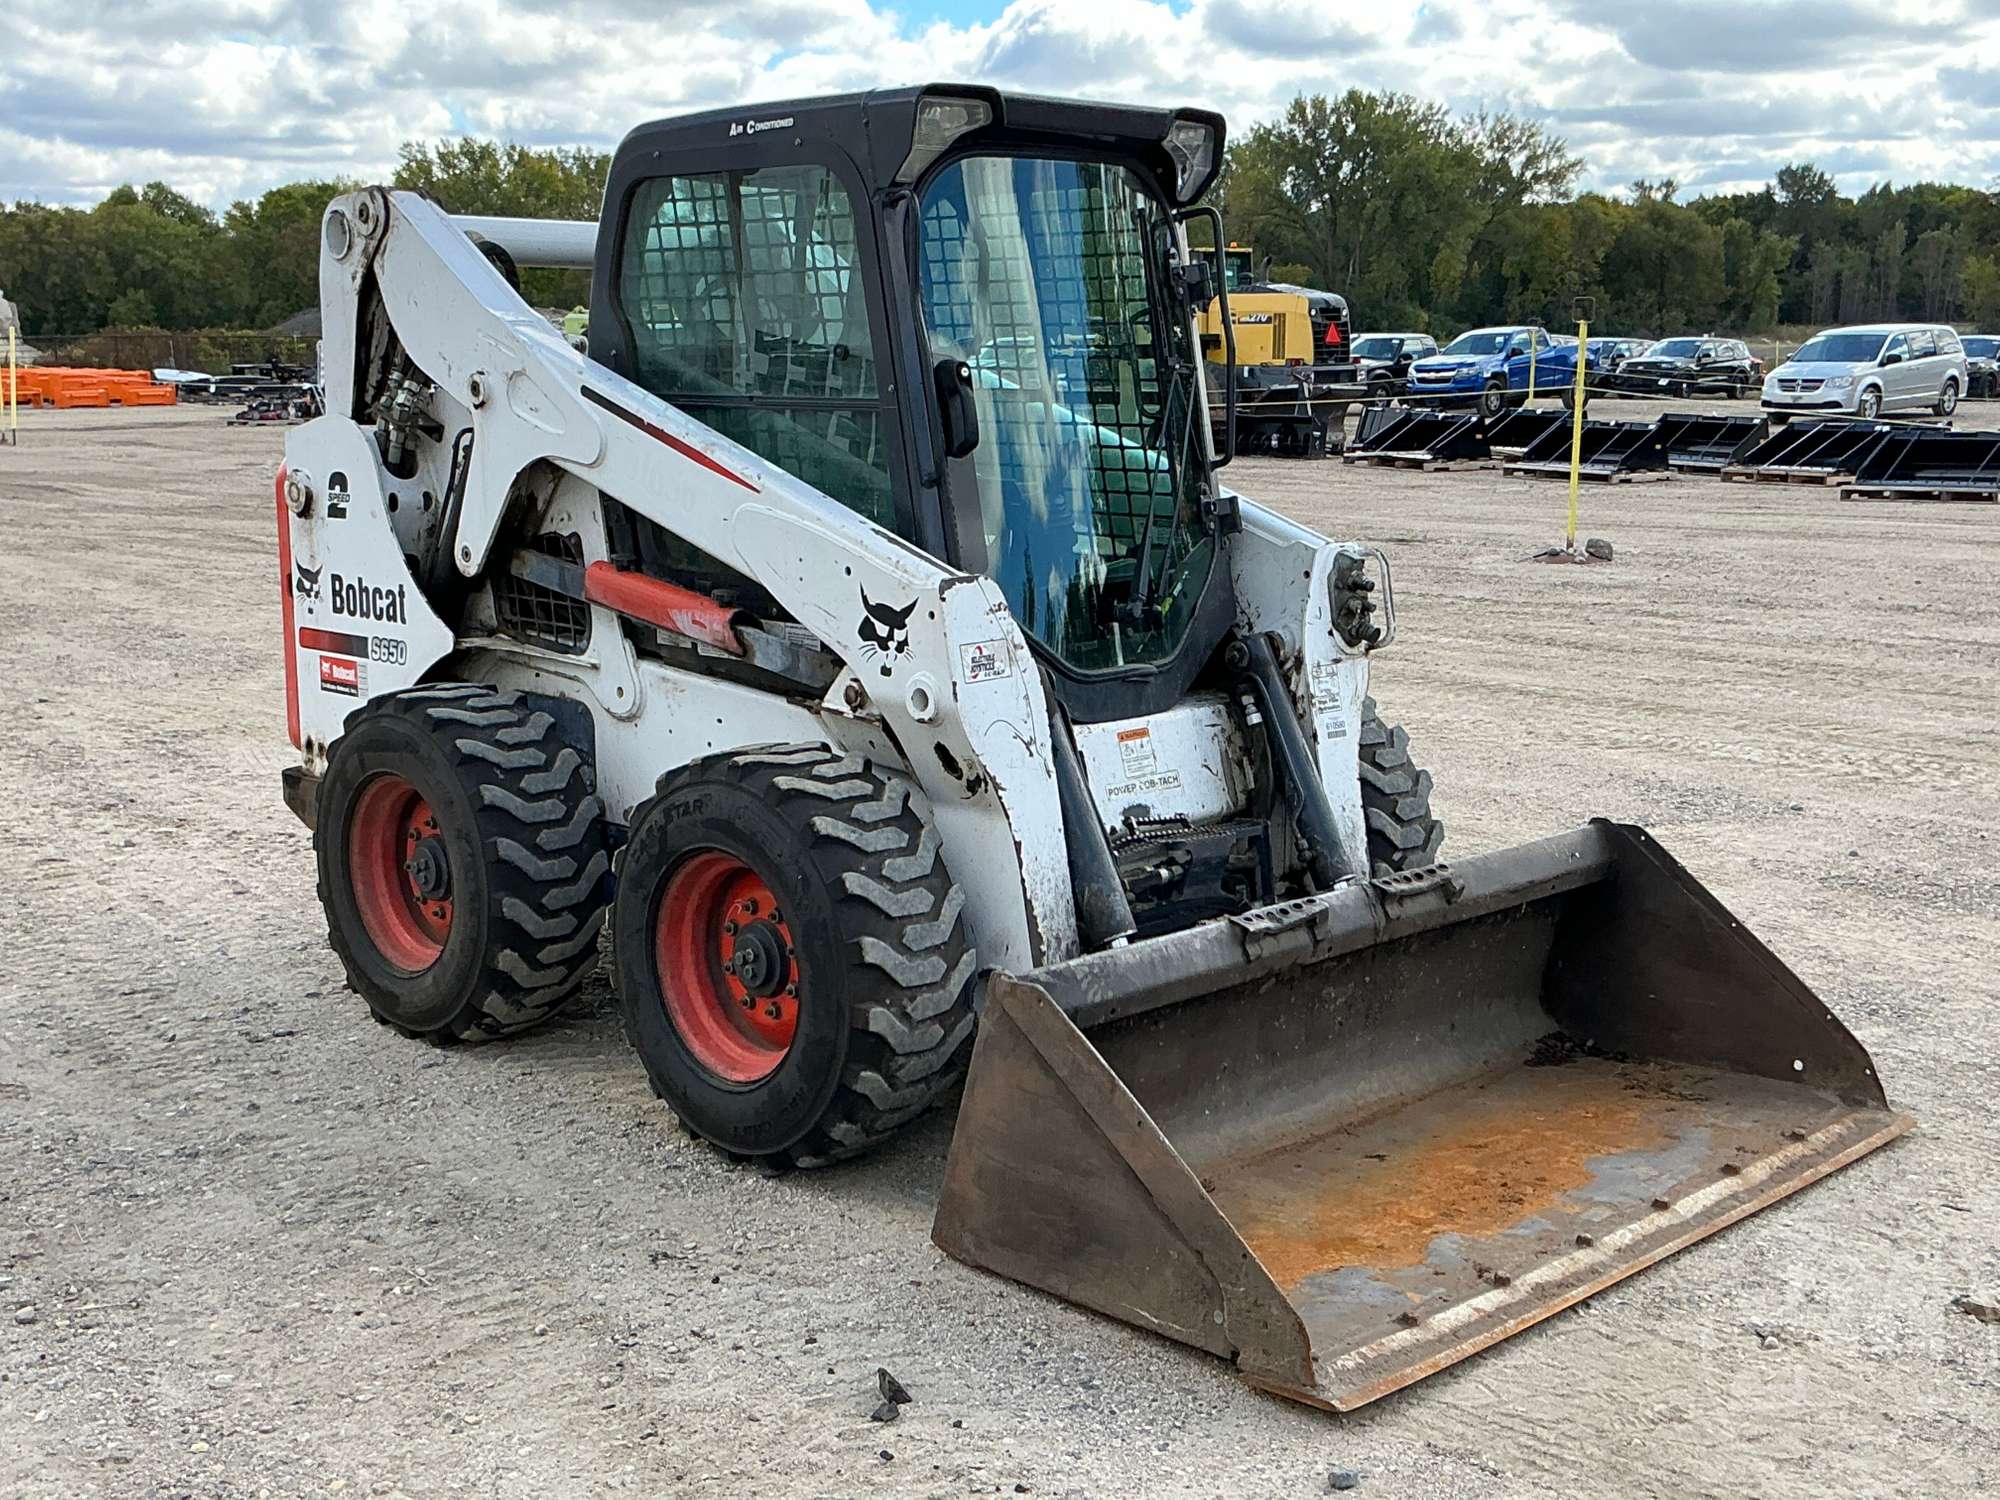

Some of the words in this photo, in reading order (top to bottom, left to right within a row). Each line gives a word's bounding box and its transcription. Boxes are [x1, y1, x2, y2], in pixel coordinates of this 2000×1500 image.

[327, 492, 351, 504] SPEED
[330, 573, 407, 625] Bobcat
[370, 636, 408, 665] S650
